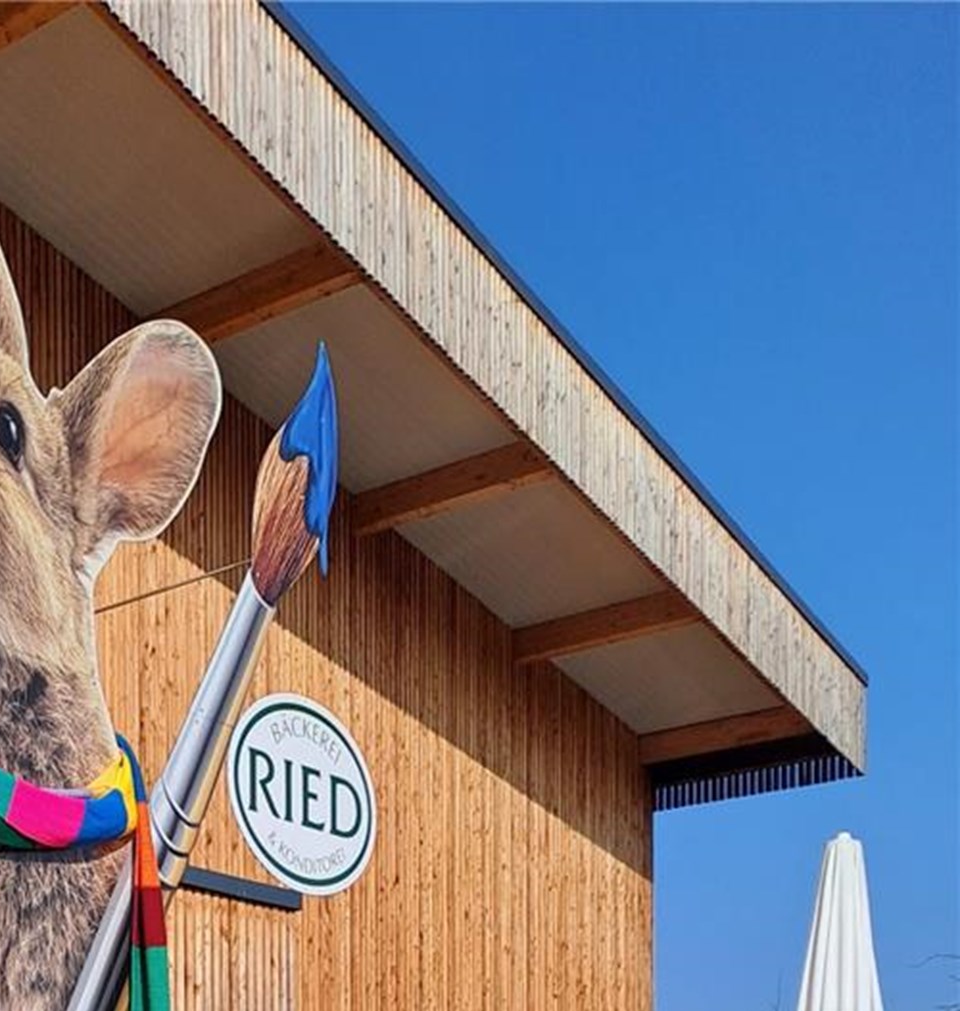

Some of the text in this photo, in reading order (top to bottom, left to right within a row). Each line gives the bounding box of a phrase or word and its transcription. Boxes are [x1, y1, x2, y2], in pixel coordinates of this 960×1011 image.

[269, 712, 342, 765] BÄCKEREI
[248, 747, 362, 838] RIED
[279, 847, 347, 875] KONDITOREI
